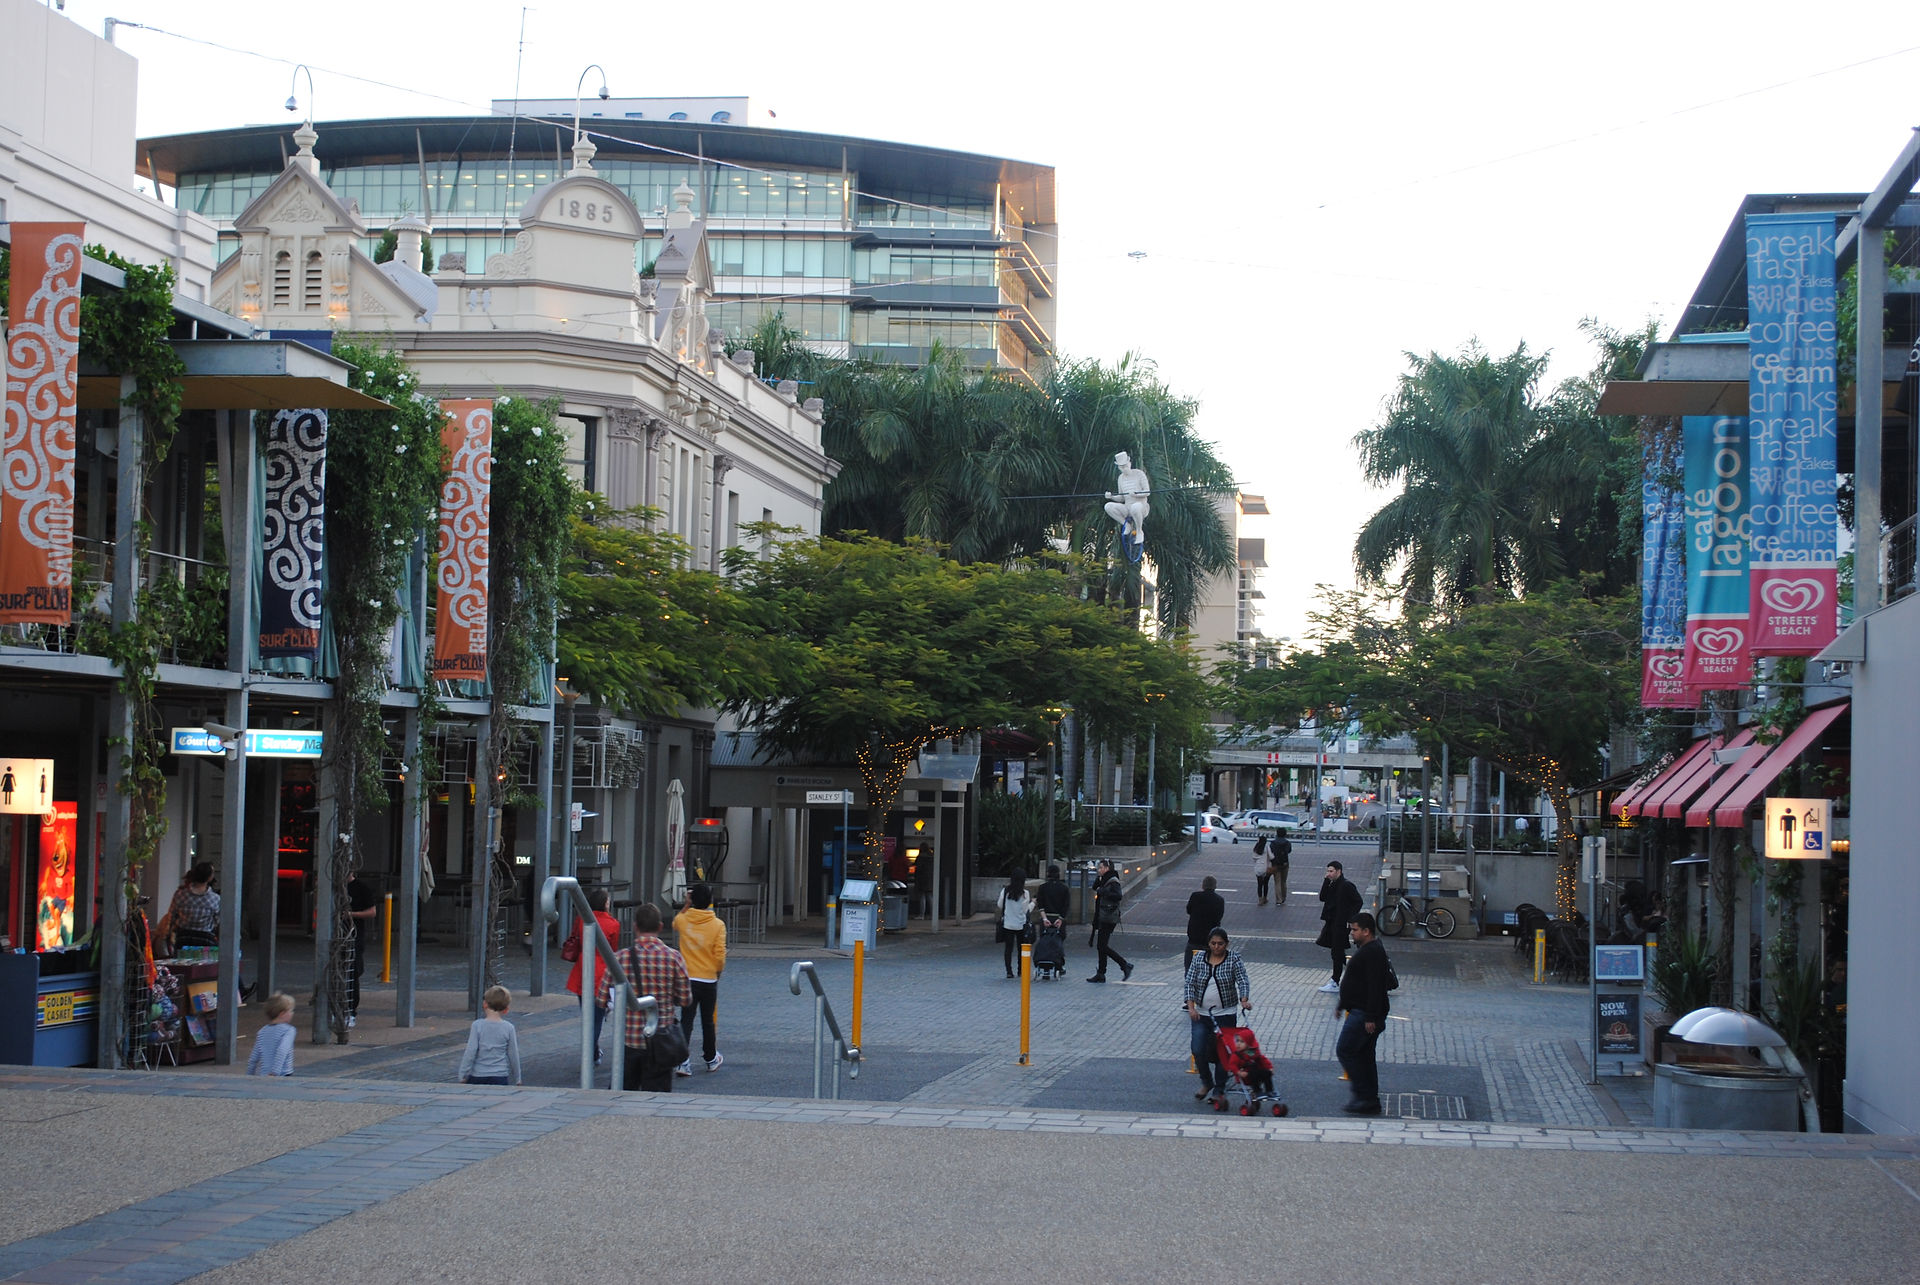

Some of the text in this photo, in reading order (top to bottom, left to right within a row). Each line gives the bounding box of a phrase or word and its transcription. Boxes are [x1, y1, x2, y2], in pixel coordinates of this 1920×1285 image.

[560, 197, 613, 223] 1885
[1754, 251, 1809, 279] fast
[1748, 277, 1800, 300] sand
[1800, 274, 1834, 287] cakes
[1754, 292, 1836, 313] wiches
[1749, 312, 1836, 343] coffee
[1779, 341, 1835, 366] chips
[1758, 366, 1834, 384] cream
[1749, 382, 1837, 413] drinks
[1757, 433, 1811, 461] fast
[1750, 459, 1801, 482] sand
[1800, 456, 1836, 470] cakes
[1756, 475, 1837, 495] wiches
[1700, 418, 1752, 577] lagoon
[1649, 510, 1684, 524] crea
[1749, 494, 1837, 525] coffee
[1685, 488, 1713, 552] café
[47, 498, 74, 586] SAVOUR
[1749, 530, 1780, 552] ice
[1780, 523, 1836, 548] chips
[1643, 543, 1677, 562] bre
[1759, 548, 1835, 561] cream
[1642, 599, 1687, 620] coffe
[468, 605, 488, 653] RELAX
[1768, 616, 1817, 625] STREETS
[260, 633, 288, 648] SURF
[1774, 627, 1811, 635] BEACH
[434, 658, 458, 670] SURF
[1698, 657, 1738, 665] STREETS
[1703, 665, 1733, 673] BEACH
[808, 793, 834, 801] STANLEY
[515, 856, 531, 865] DM
[597, 844, 610, 865] DM
[46, 996, 72, 1008] GOLDEN
[1600, 1002, 1625, 1011] NOW
[47, 1008, 70, 1021] CASKET
